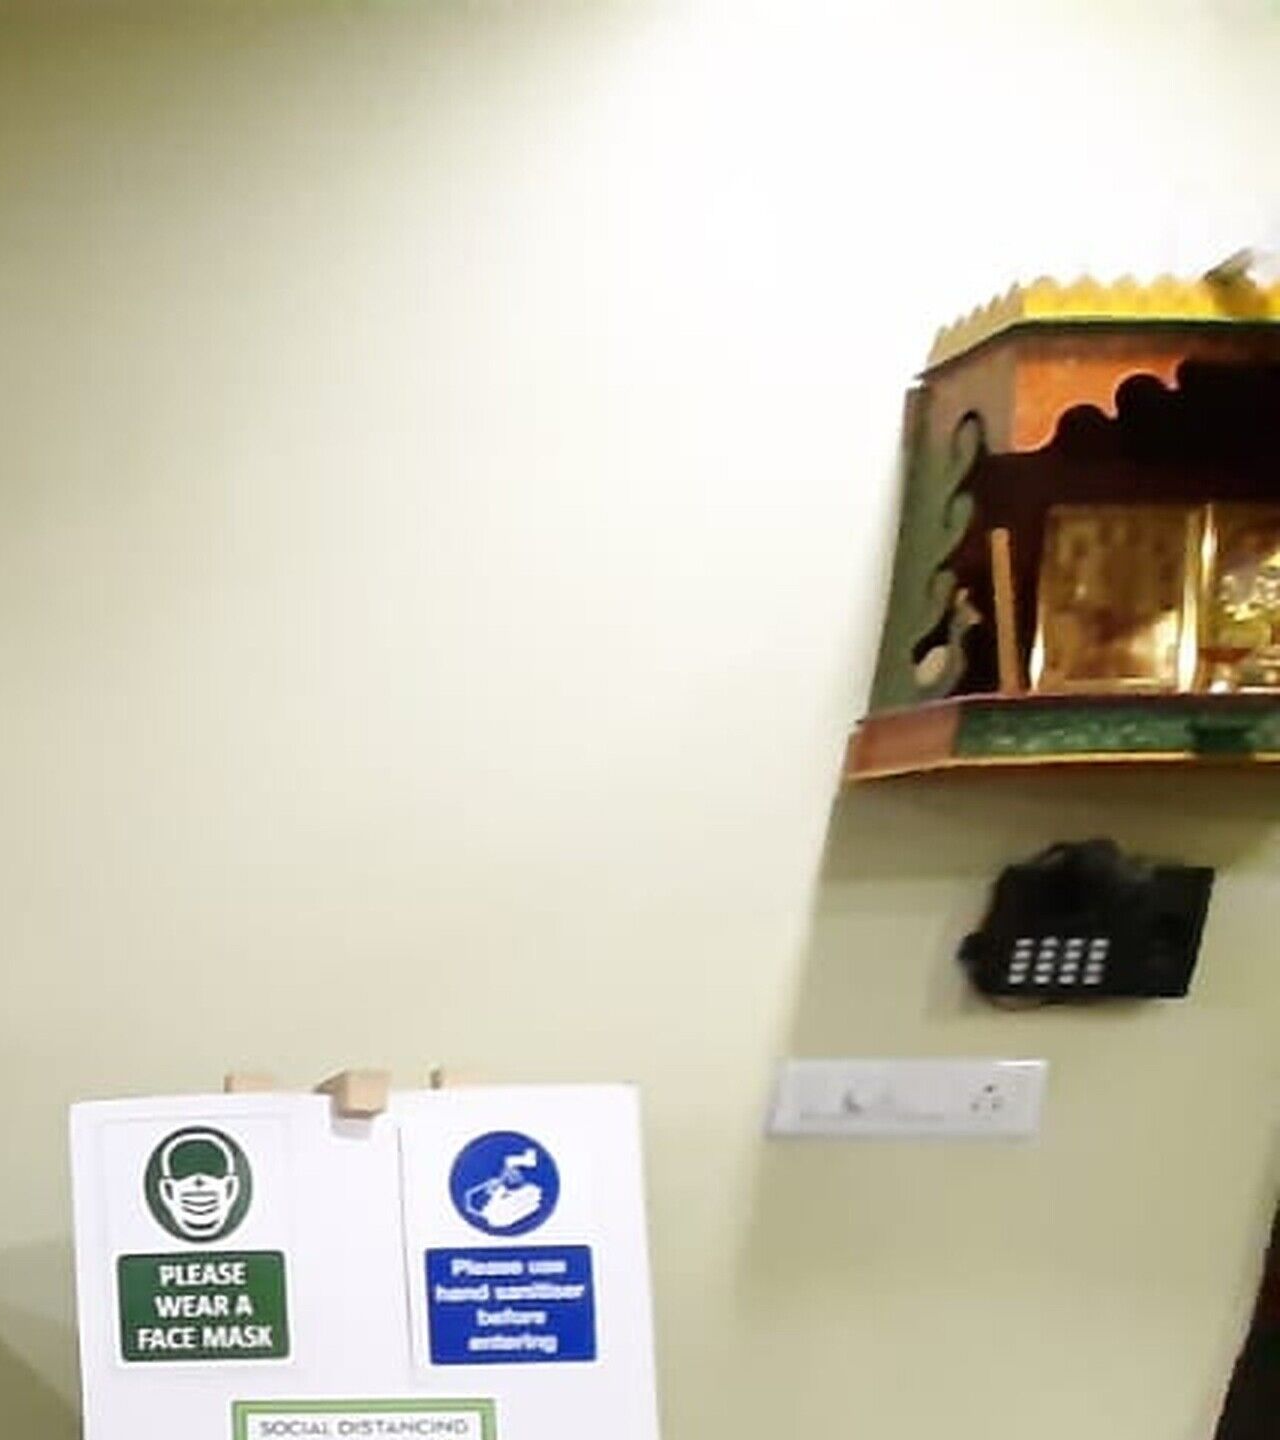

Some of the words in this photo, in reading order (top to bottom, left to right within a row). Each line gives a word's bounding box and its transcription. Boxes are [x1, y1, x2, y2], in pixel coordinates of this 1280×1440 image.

[158, 1261, 247, 1287] PLEASE
[451, 1258, 524, 1277] Please
[528, 1260, 567, 1275] use
[436, 1283, 489, 1302] hand
[154, 1294, 229, 1318] WEAR
[235, 1293, 254, 1316] A
[476, 1307, 548, 1327] before
[137, 1326, 198, 1350] FACE
[202, 1324, 273, 1348] MASK
[469, 1333, 558, 1354] entering
[260, 1420, 328, 1437] SOCIAL
[337, 1418, 469, 1437] DISTANCING
